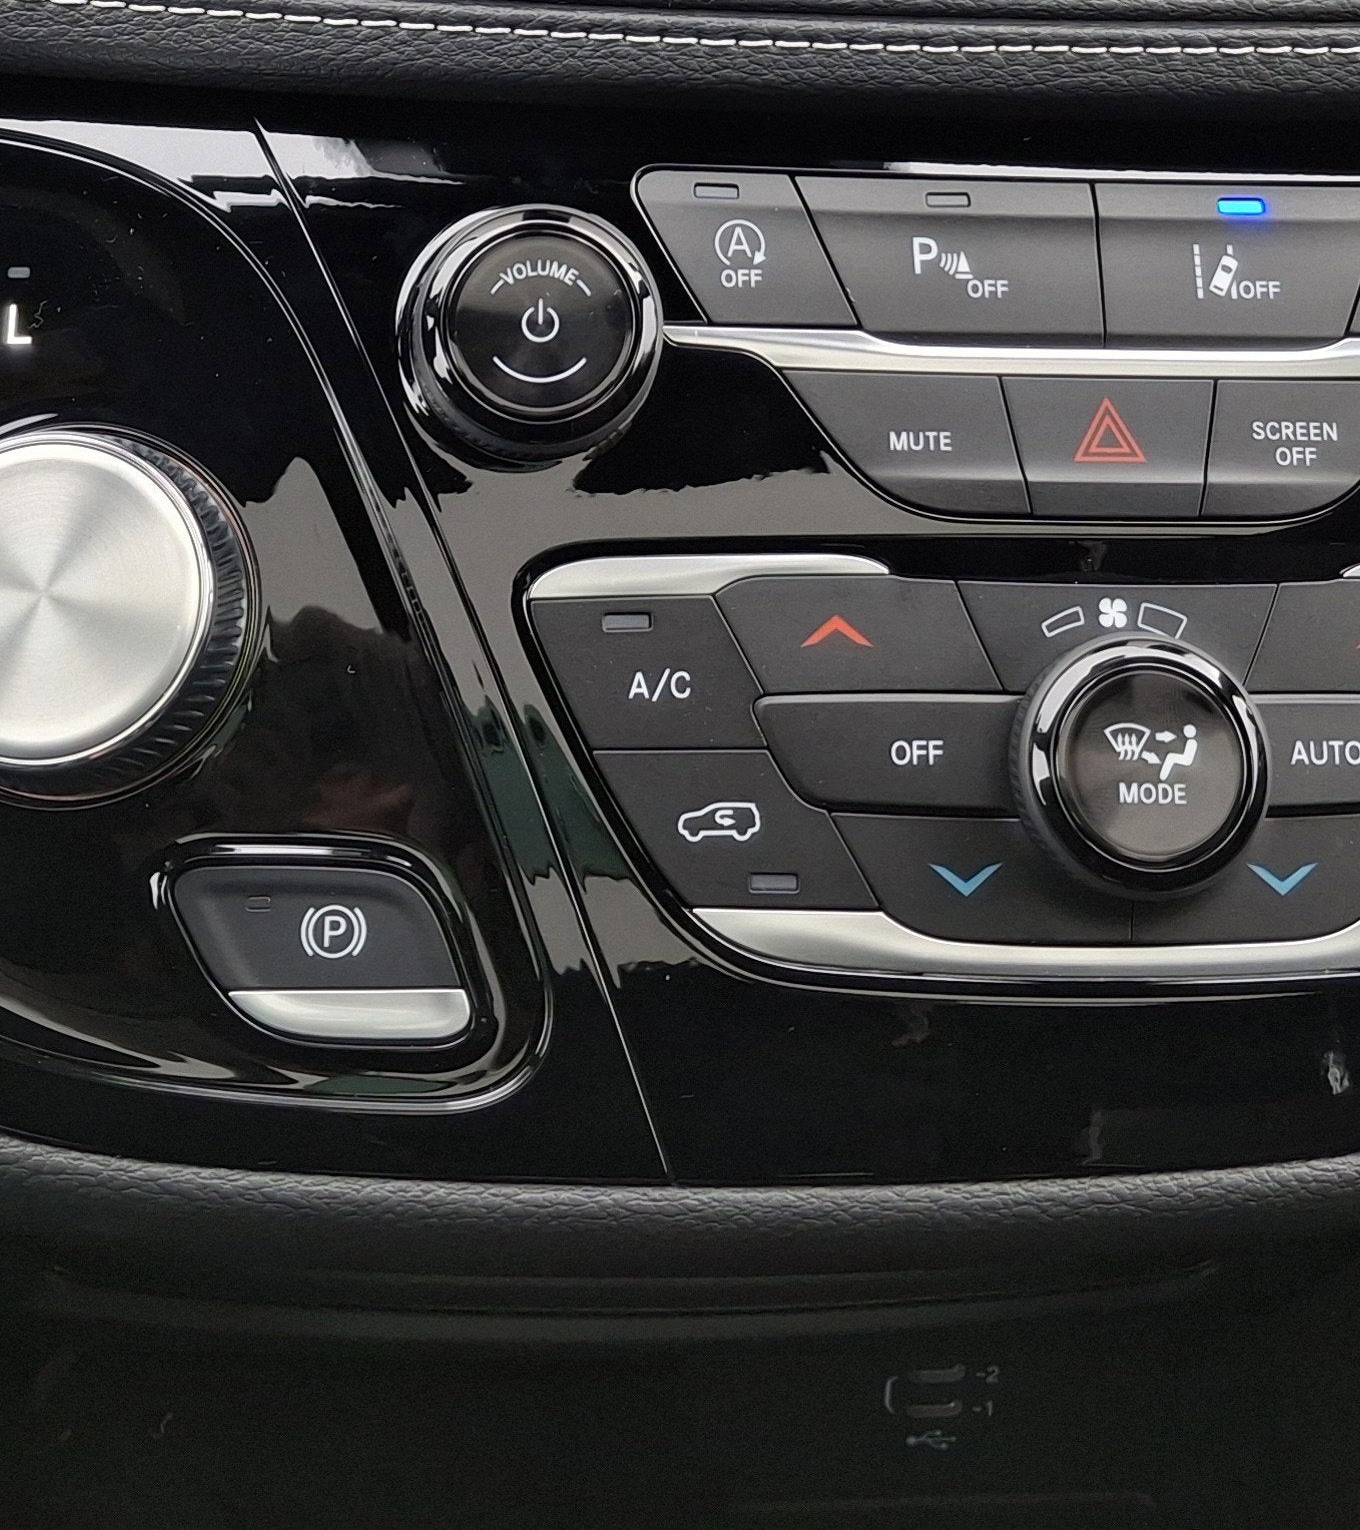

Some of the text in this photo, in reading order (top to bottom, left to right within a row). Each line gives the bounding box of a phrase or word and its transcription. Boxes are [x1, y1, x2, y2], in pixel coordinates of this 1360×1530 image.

[498, 260, 581, 288] VOLUME
[720, 268, 763, 288] OFF
[967, 279, 1009, 299] OFF
[1240, 279, 1283, 301] OFF
[889, 431, 953, 452] MUTE
[1252, 421, 1338, 442] SCREEN
[1275, 446, 1317, 467] OFF
[628, 668, 691, 702] A/C
[890, 739, 944, 766] OFF
[1119, 782, 1188, 805] MODE
